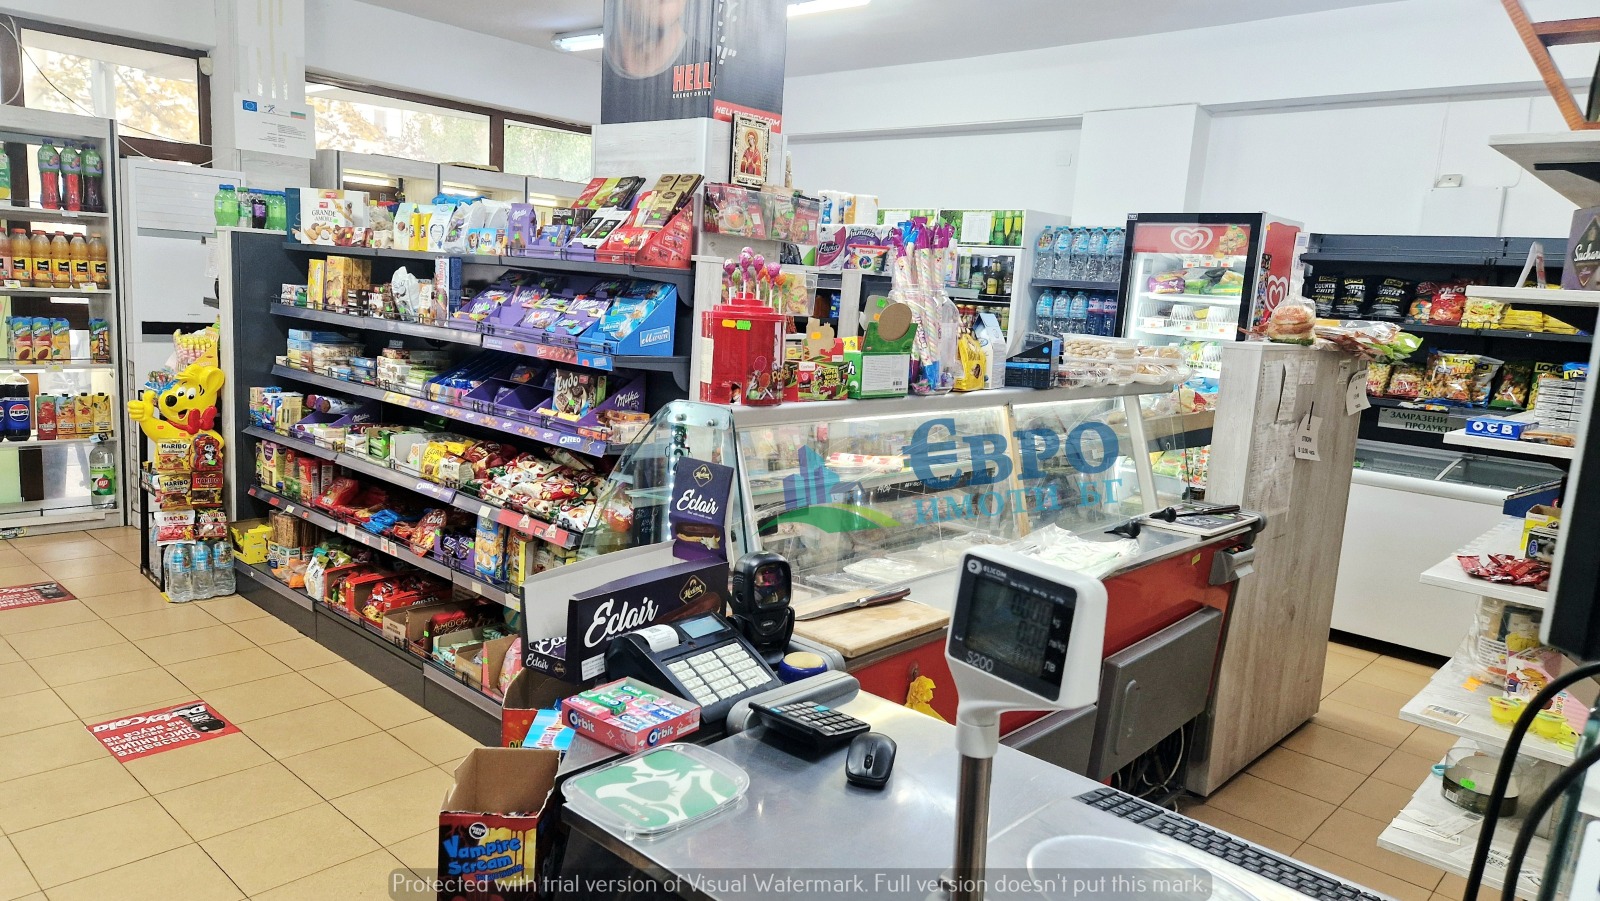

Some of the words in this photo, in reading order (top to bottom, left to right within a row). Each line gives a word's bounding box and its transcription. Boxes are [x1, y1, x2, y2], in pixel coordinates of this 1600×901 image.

[673, 62, 712, 92] HELL
[311, 209, 336, 218] GRANDE
[849, 228, 876, 238] familia
[614, 390, 640, 407] Milka
[1390, 410, 1448, 424] ЗАМРАЗЕНИ
[1472, 421, 1514, 435] OCB
[559, 436, 582, 444] OREO
[164, 479, 188, 487] HARIBO
[676, 489, 719, 516] Eclair
[983, 565, 1007, 577] ELICOM
[583, 597, 660, 649] Eclair
[525, 653, 549, 670] Eclair
[966, 650, 995, 673] S200
[622, 685, 643, 695] Orbit
[568, 709, 595, 733] Orbit
[648, 724, 674, 745] Orbit
[116, 732, 201, 757] Спазвайте
[442, 833, 522, 860] Vampire
[447, 854, 513, 876] Scream
